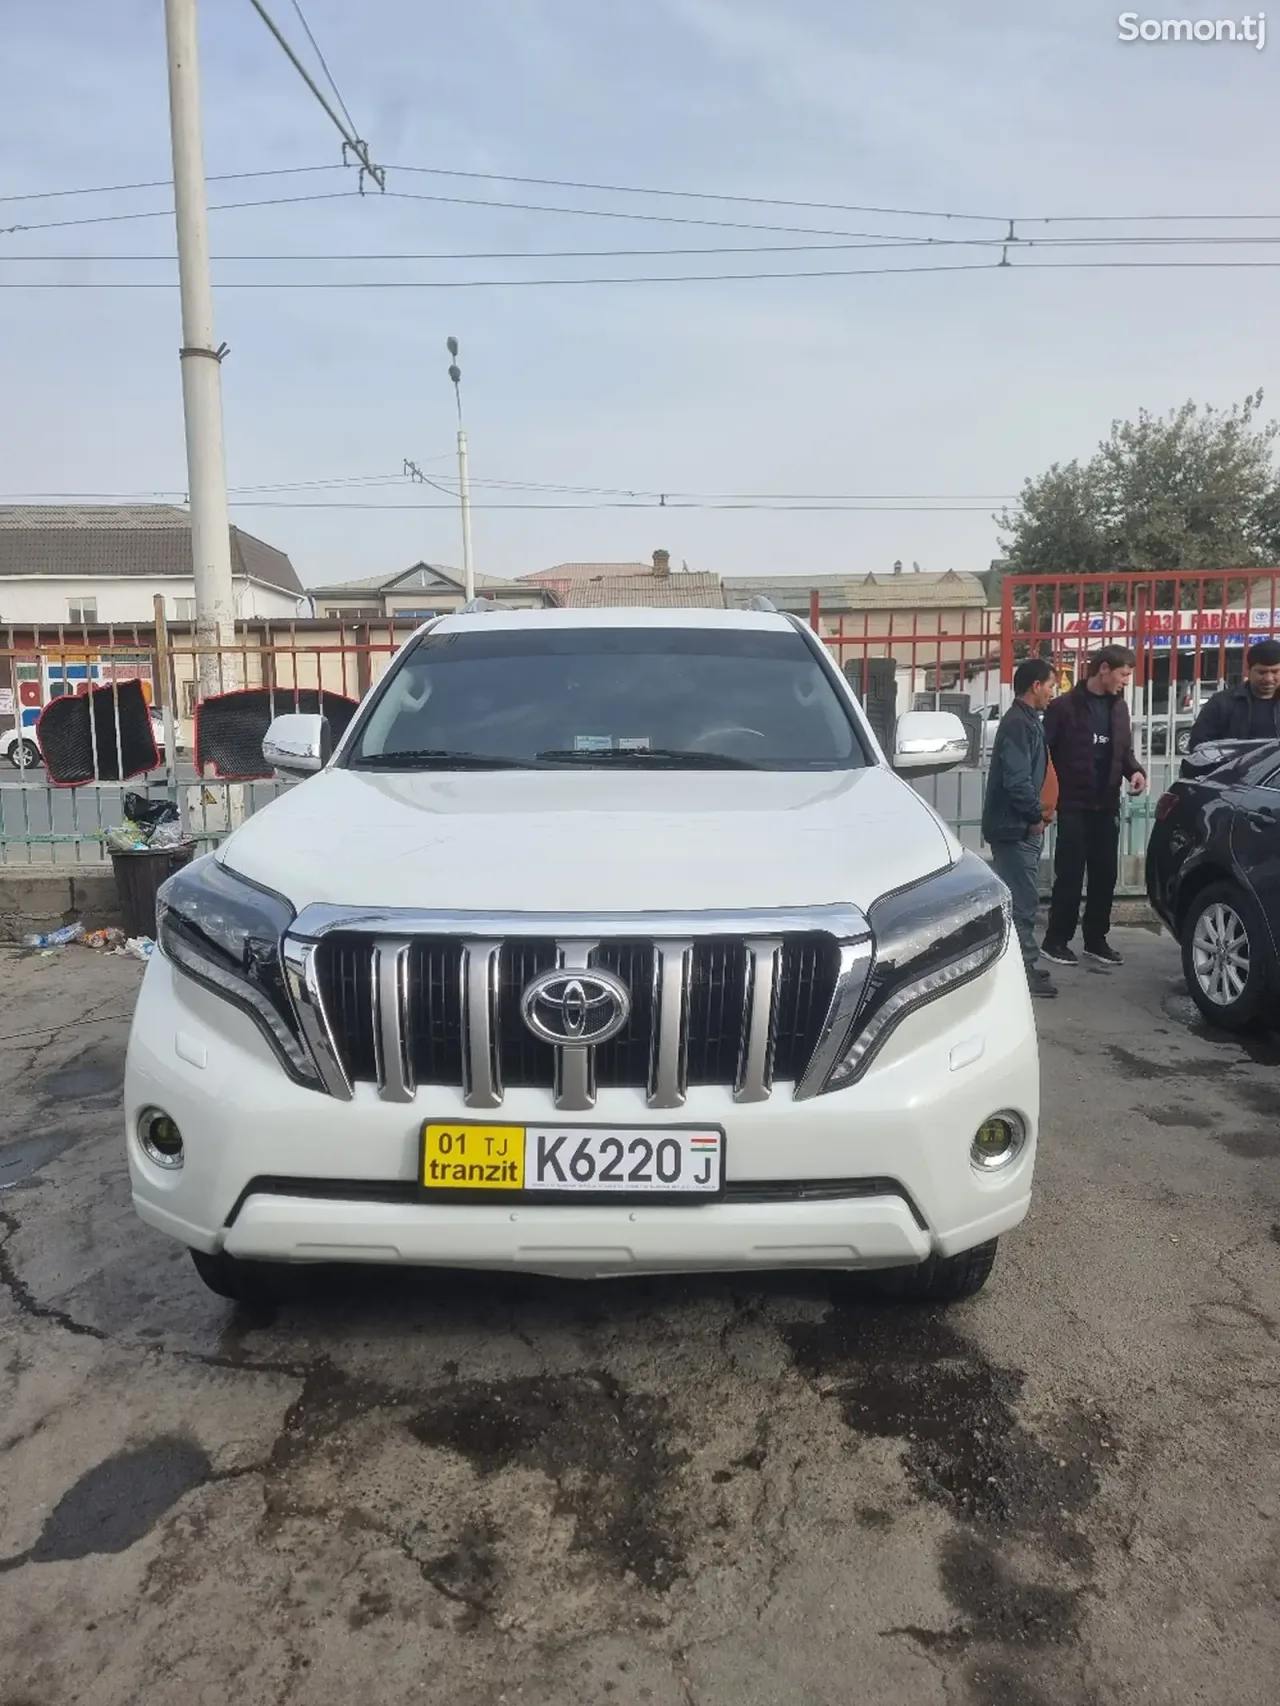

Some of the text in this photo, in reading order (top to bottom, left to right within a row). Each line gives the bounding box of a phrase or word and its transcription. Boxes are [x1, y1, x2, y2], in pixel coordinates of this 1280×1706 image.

[438, 1132, 508, 1156] 01 TJ
[429, 1158, 518, 1182] tranzit
[537, 1136, 711, 1185] K6220 J
